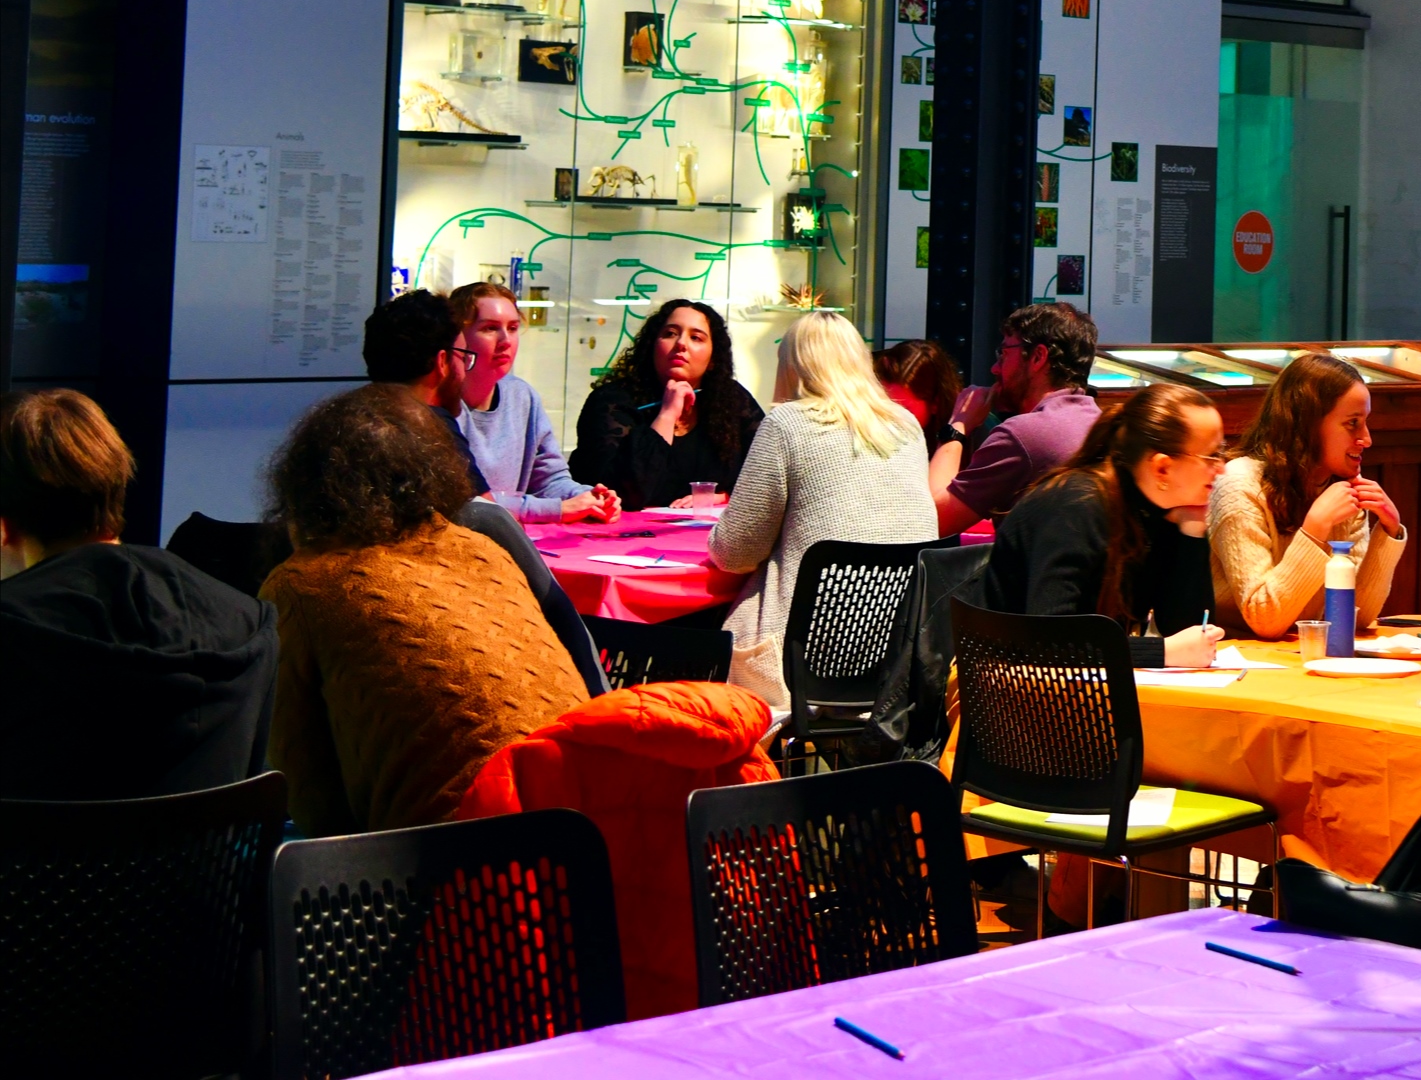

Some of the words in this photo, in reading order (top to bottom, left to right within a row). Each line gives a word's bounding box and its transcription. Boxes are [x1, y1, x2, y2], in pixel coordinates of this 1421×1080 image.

[24, 113, 47, 123] man
[48, 111, 96, 124] evolution
[1161, 163, 1197, 176] Biodiversity
[1236, 232, 1272, 244] EDUCATION
[1243, 243, 1264, 256] ROOM
